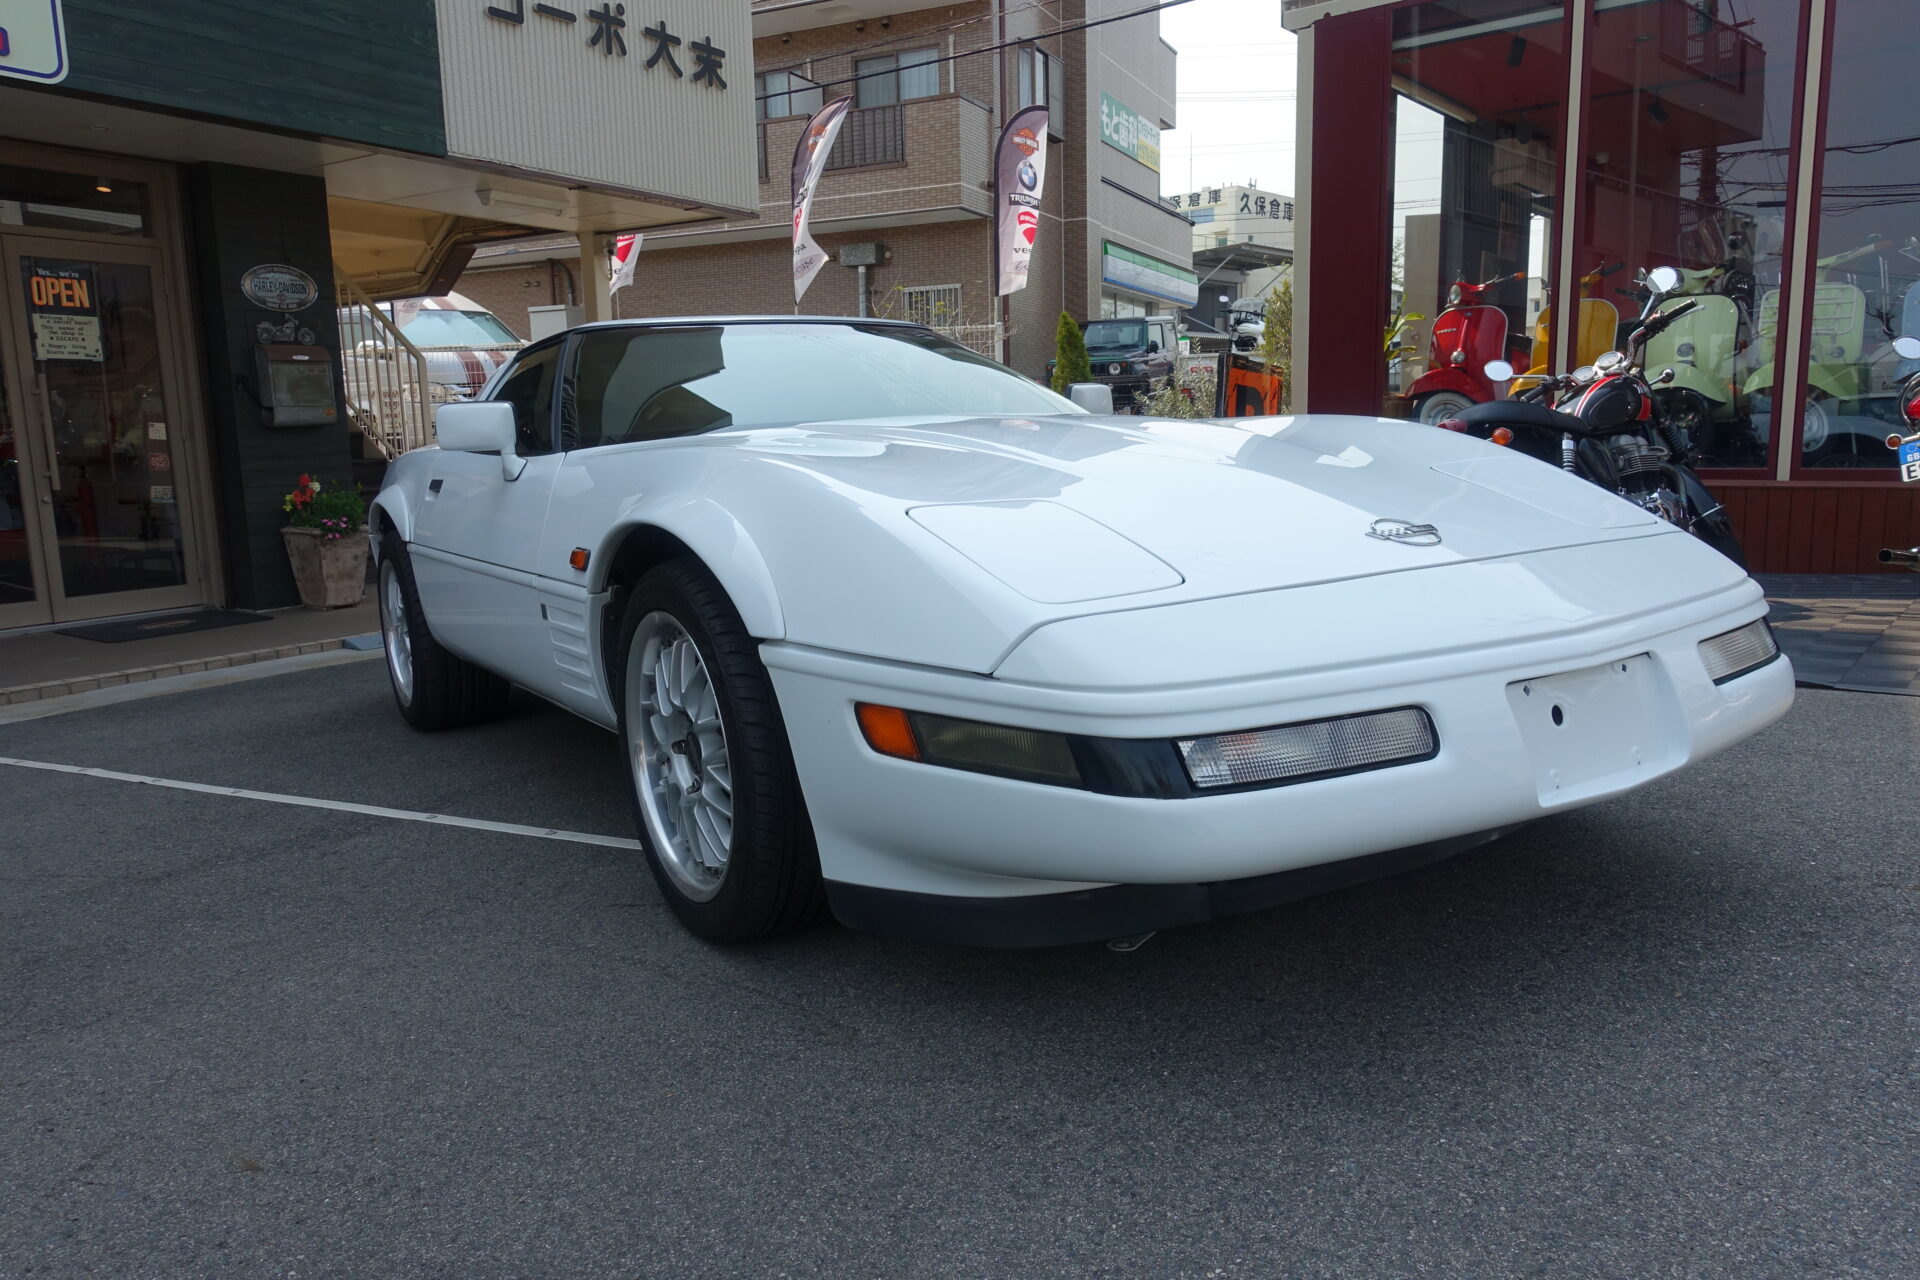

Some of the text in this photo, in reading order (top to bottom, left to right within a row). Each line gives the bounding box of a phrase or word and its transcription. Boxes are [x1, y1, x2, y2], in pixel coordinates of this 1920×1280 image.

[1240, 192, 1294, 222] 久保倉庫
[31, 276, 90, 308] OPEN
[253, 279, 308, 295] HARLEY-DAVIDSON
[1906, 463, 1920, 480] E
